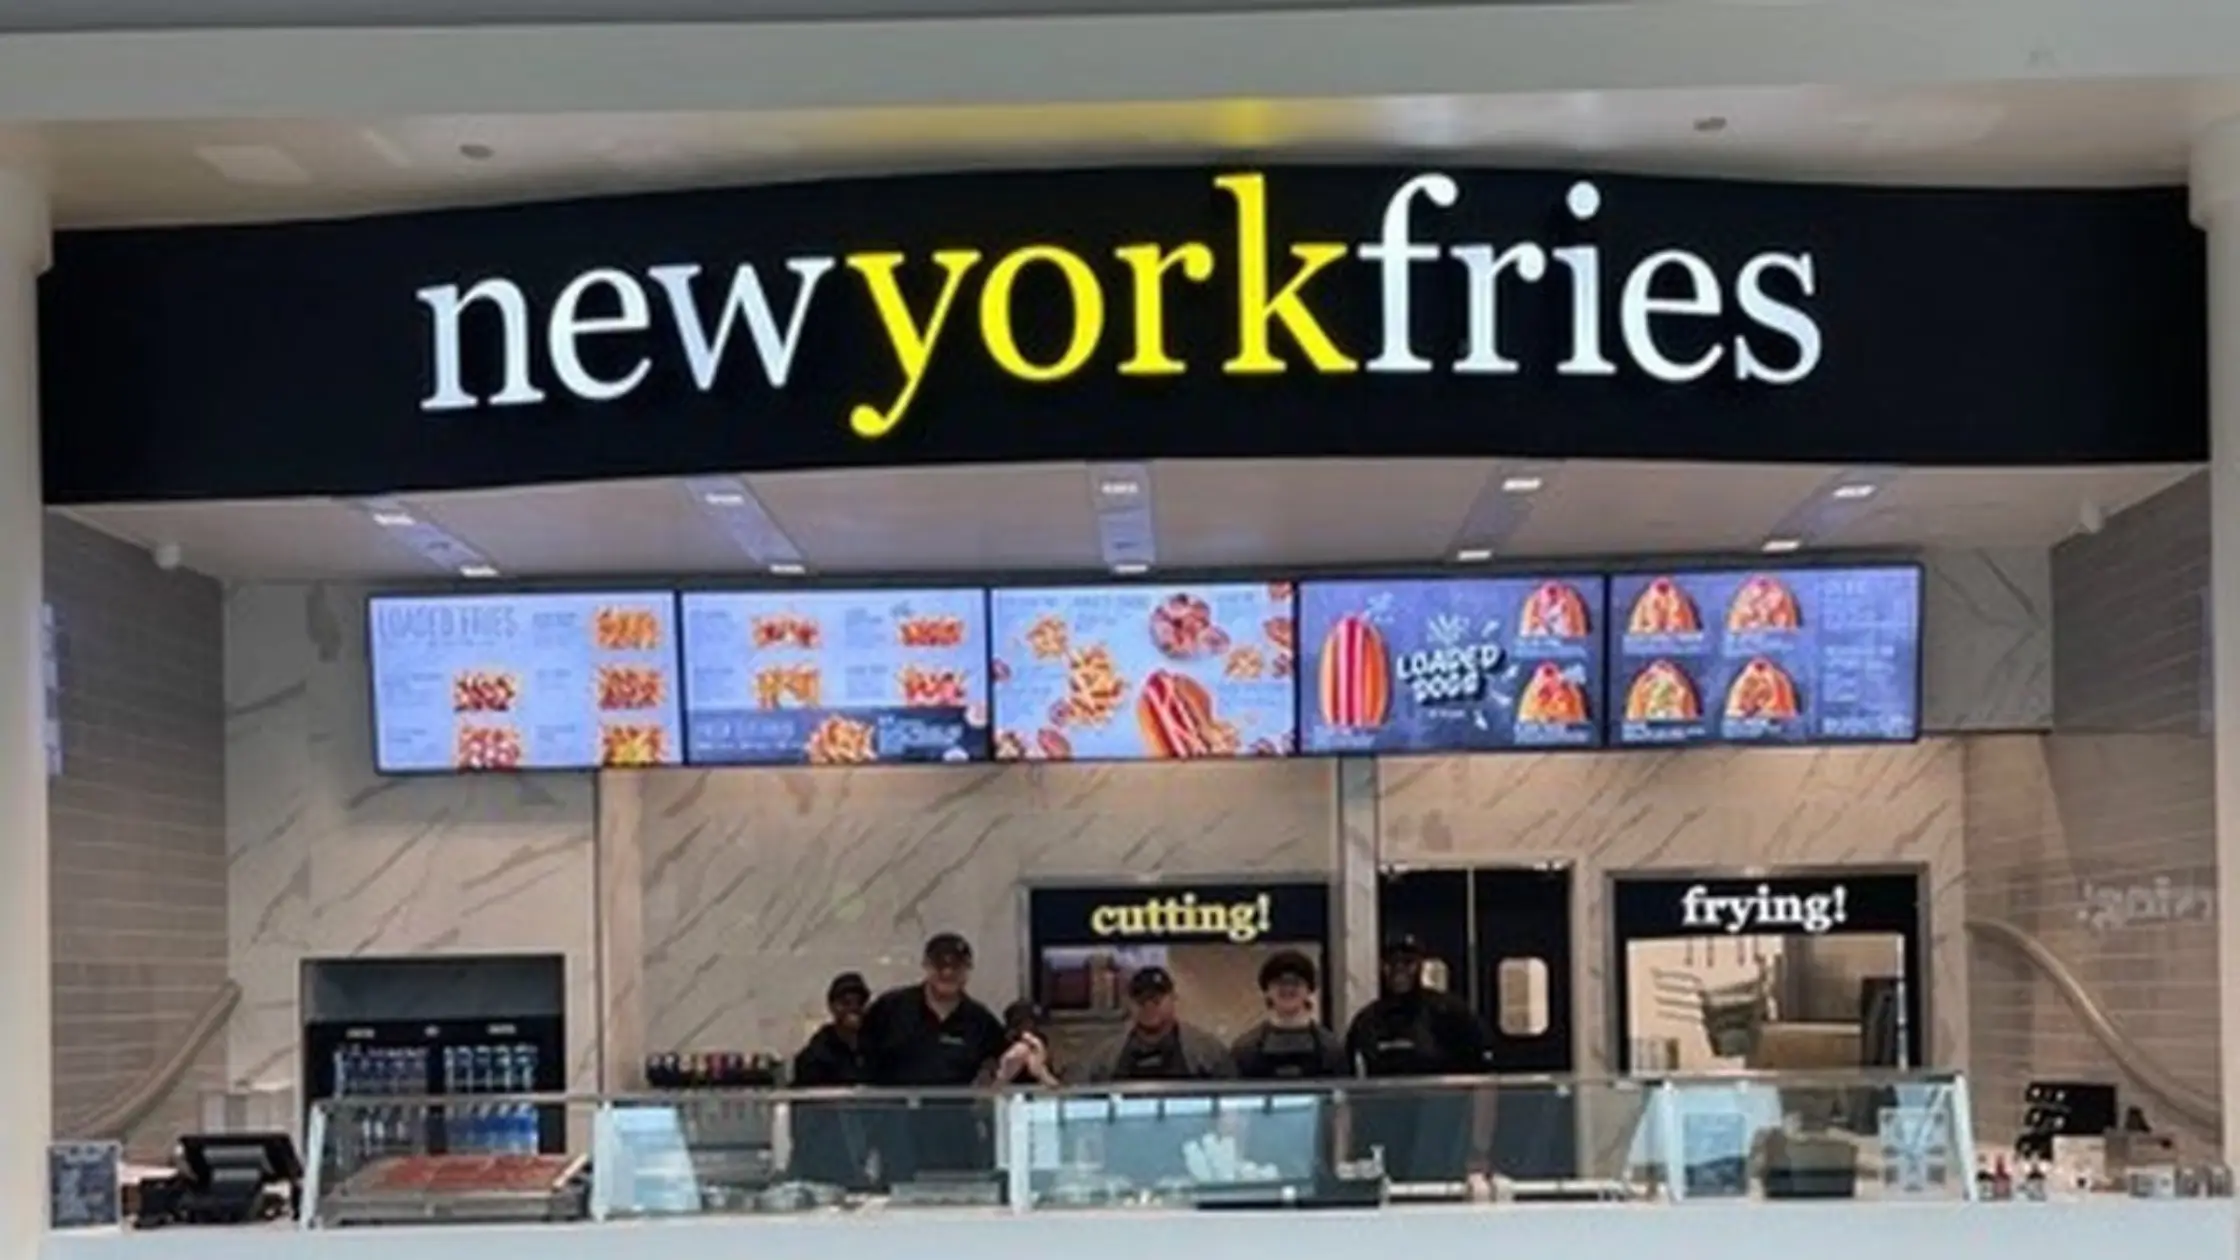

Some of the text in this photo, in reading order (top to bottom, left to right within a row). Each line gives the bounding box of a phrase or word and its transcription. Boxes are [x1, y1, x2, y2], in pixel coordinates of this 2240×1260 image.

[1397, 644, 1500, 680] LOADED
[1091, 892, 1270, 942] cutting!
[1681, 883, 1847, 933] frying!
